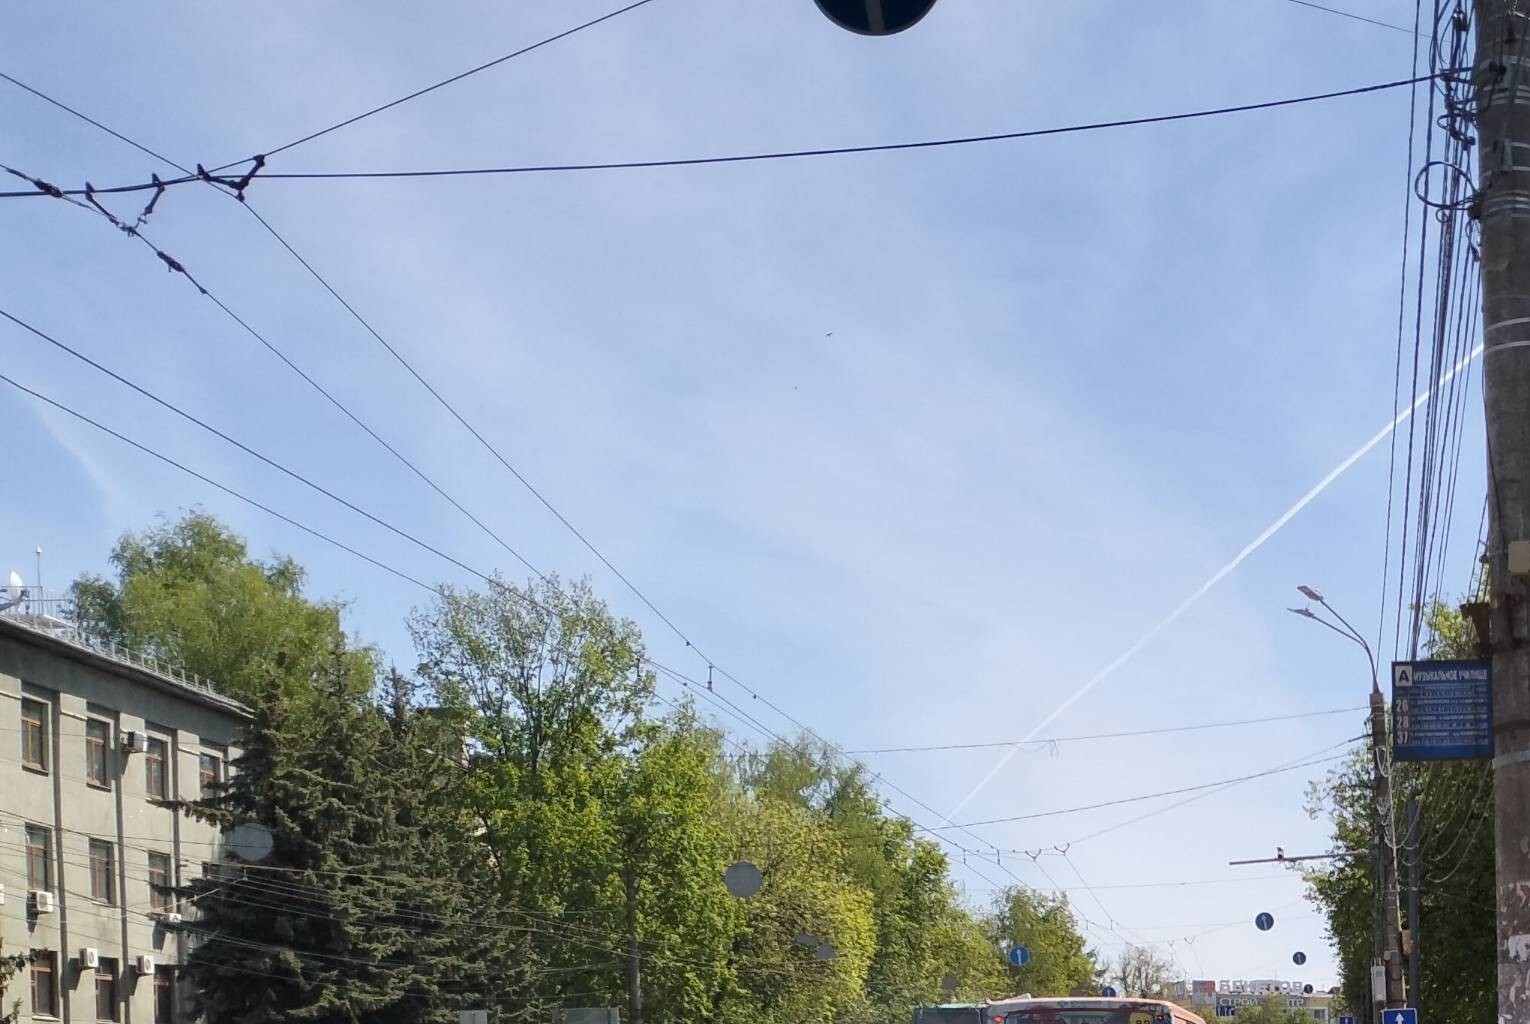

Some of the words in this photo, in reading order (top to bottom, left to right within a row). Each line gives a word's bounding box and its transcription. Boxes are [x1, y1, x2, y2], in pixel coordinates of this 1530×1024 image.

[1413, 670, 1458, 682] МУЗЫКАЛЬНОЕ
[1459, 669, 1488, 681] УЧИЛИЩЕ
[1396, 699, 1409, 713] 26
[1396, 716, 1409, 729] 28
[1397, 732, 1408, 744] 37
